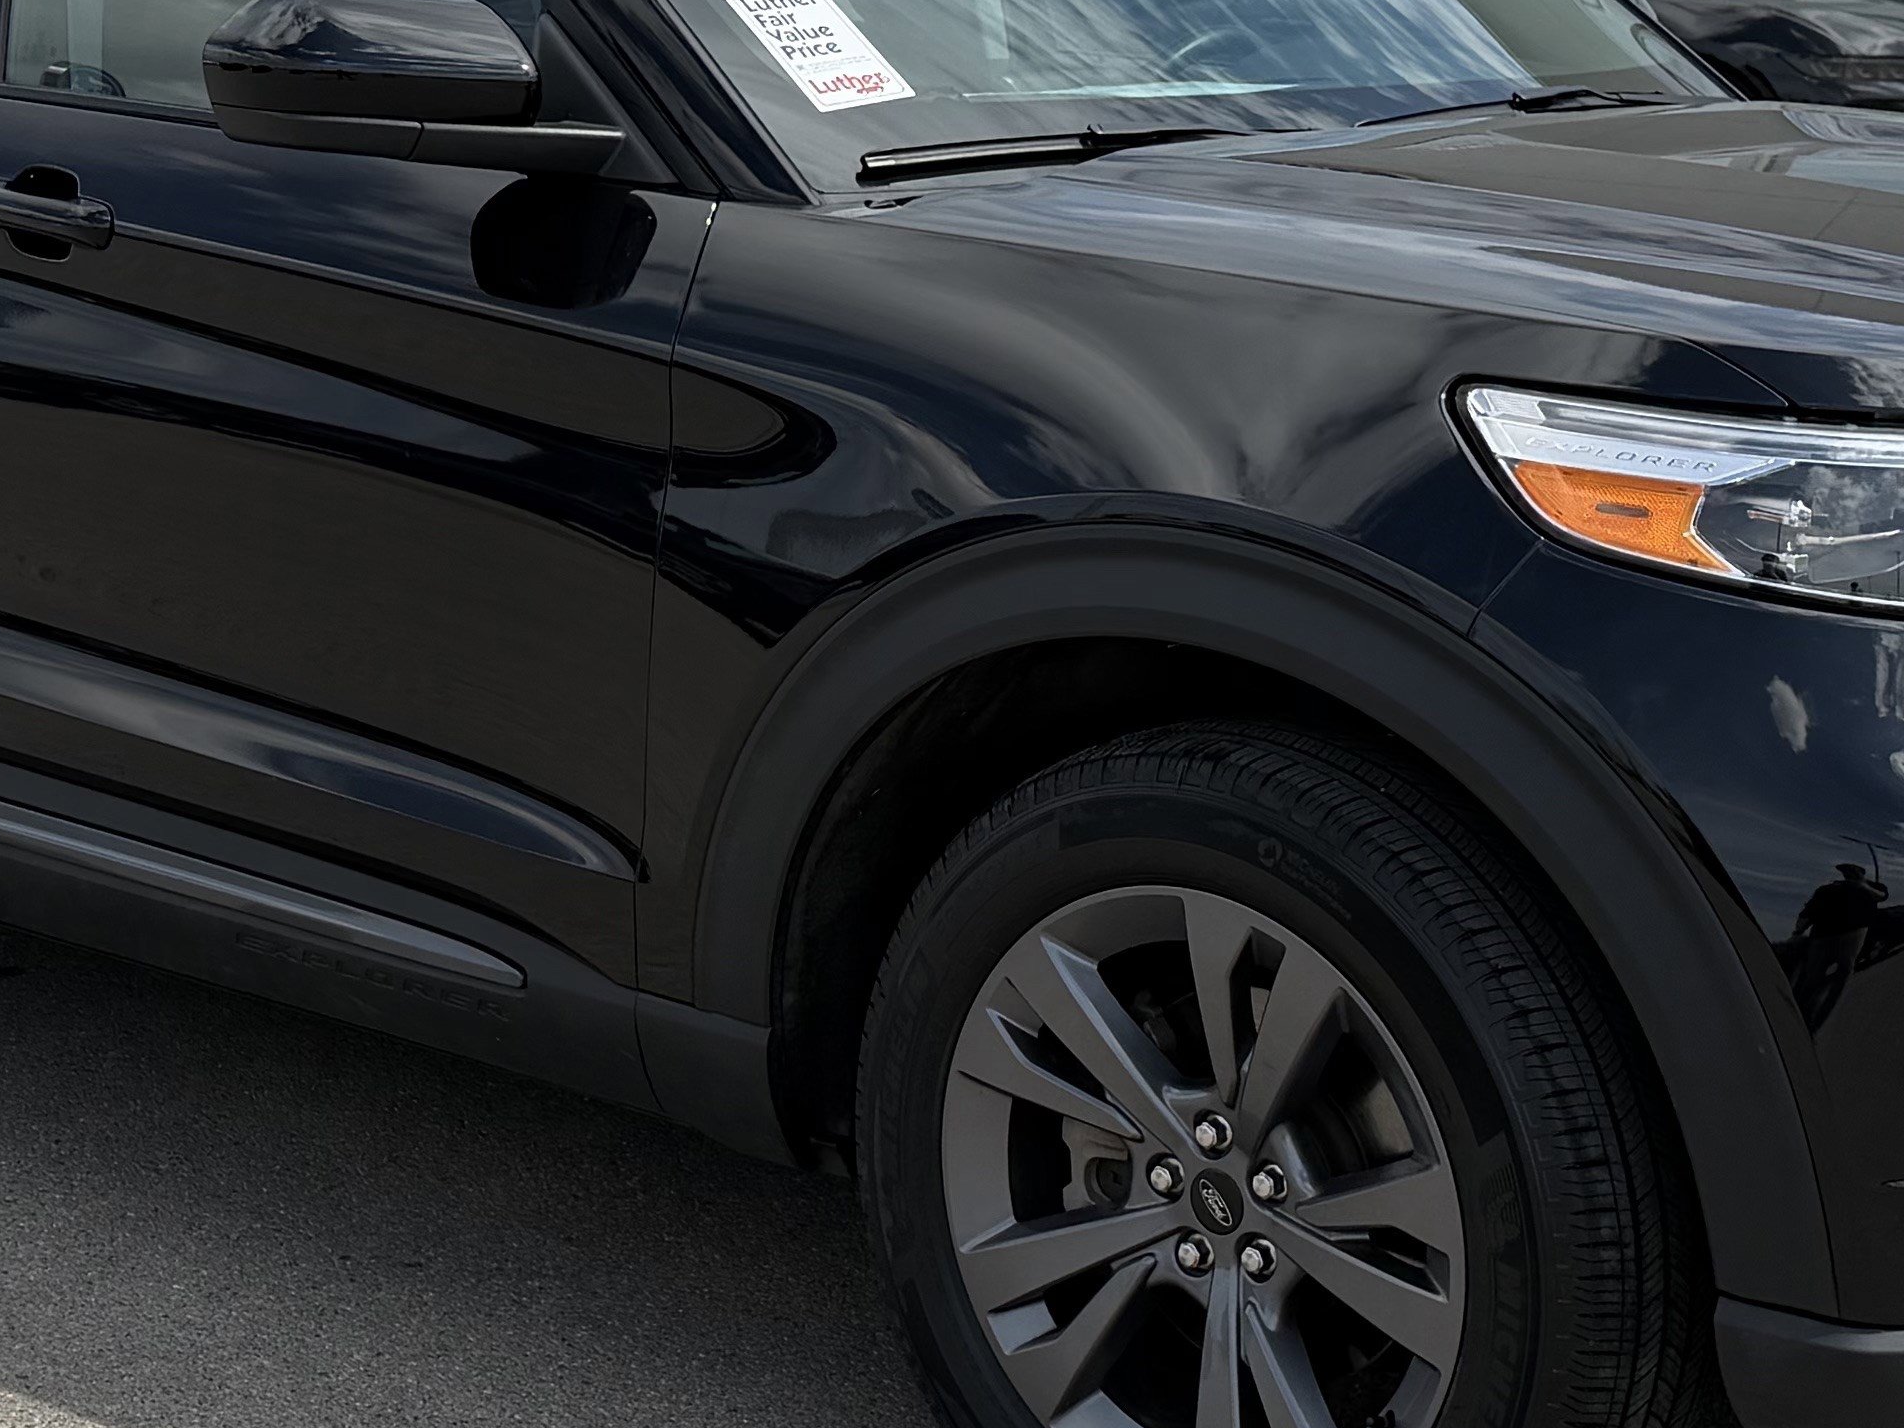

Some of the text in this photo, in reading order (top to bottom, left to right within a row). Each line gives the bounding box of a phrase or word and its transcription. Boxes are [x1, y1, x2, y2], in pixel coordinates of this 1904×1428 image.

[753, 10, 797, 29] Fair
[765, 25, 834, 43] Value
[780, 42, 843, 60] Price
[808, 72, 885, 95] Luther
[1524, 436, 1719, 474] EXPLORER
[235, 932, 512, 1023] EXPLORER
